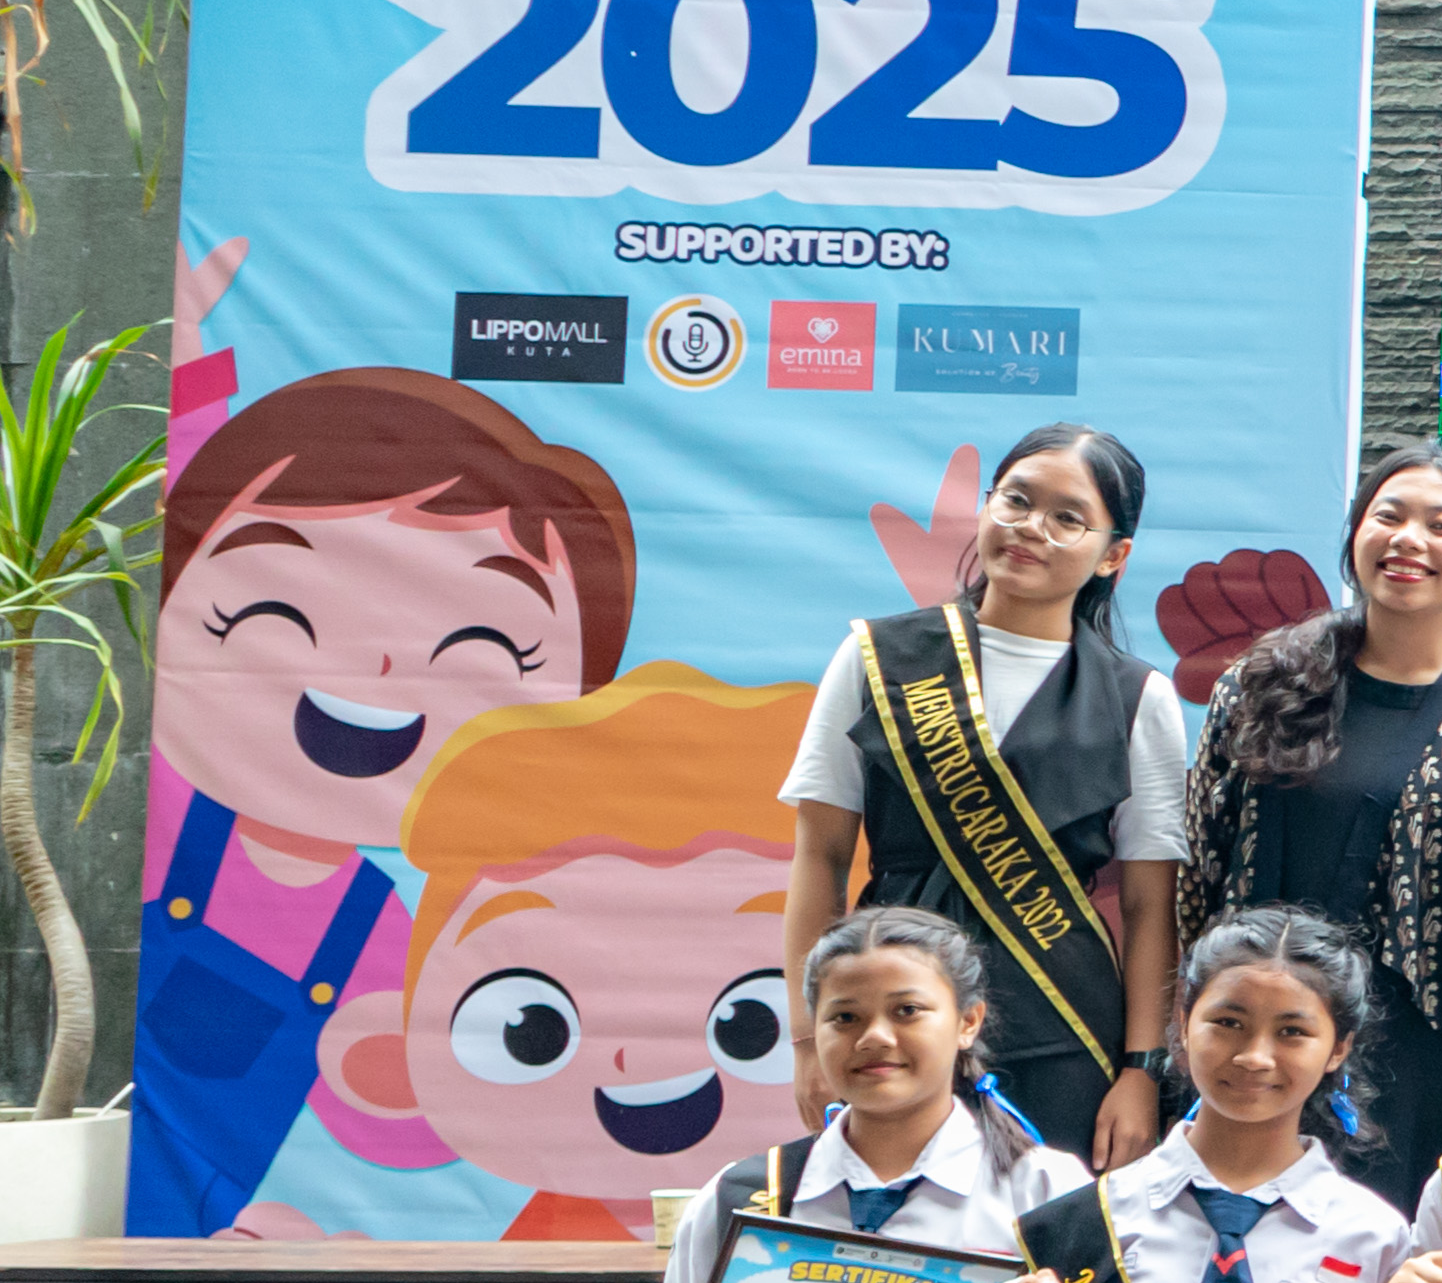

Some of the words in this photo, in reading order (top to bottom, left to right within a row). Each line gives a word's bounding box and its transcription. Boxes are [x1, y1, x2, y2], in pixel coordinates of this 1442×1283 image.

[616, 221, 878, 268] SUPPORTED
[878, 229, 950, 270] BY:
[507, 347, 572, 357] KUTA
[913, 327, 1067, 356] KUMARI
[780, 347, 862, 367] emina
[902, 673, 1037, 902] MENSTRUCARAKA
[1012, 887, 1074, 952] 2022
